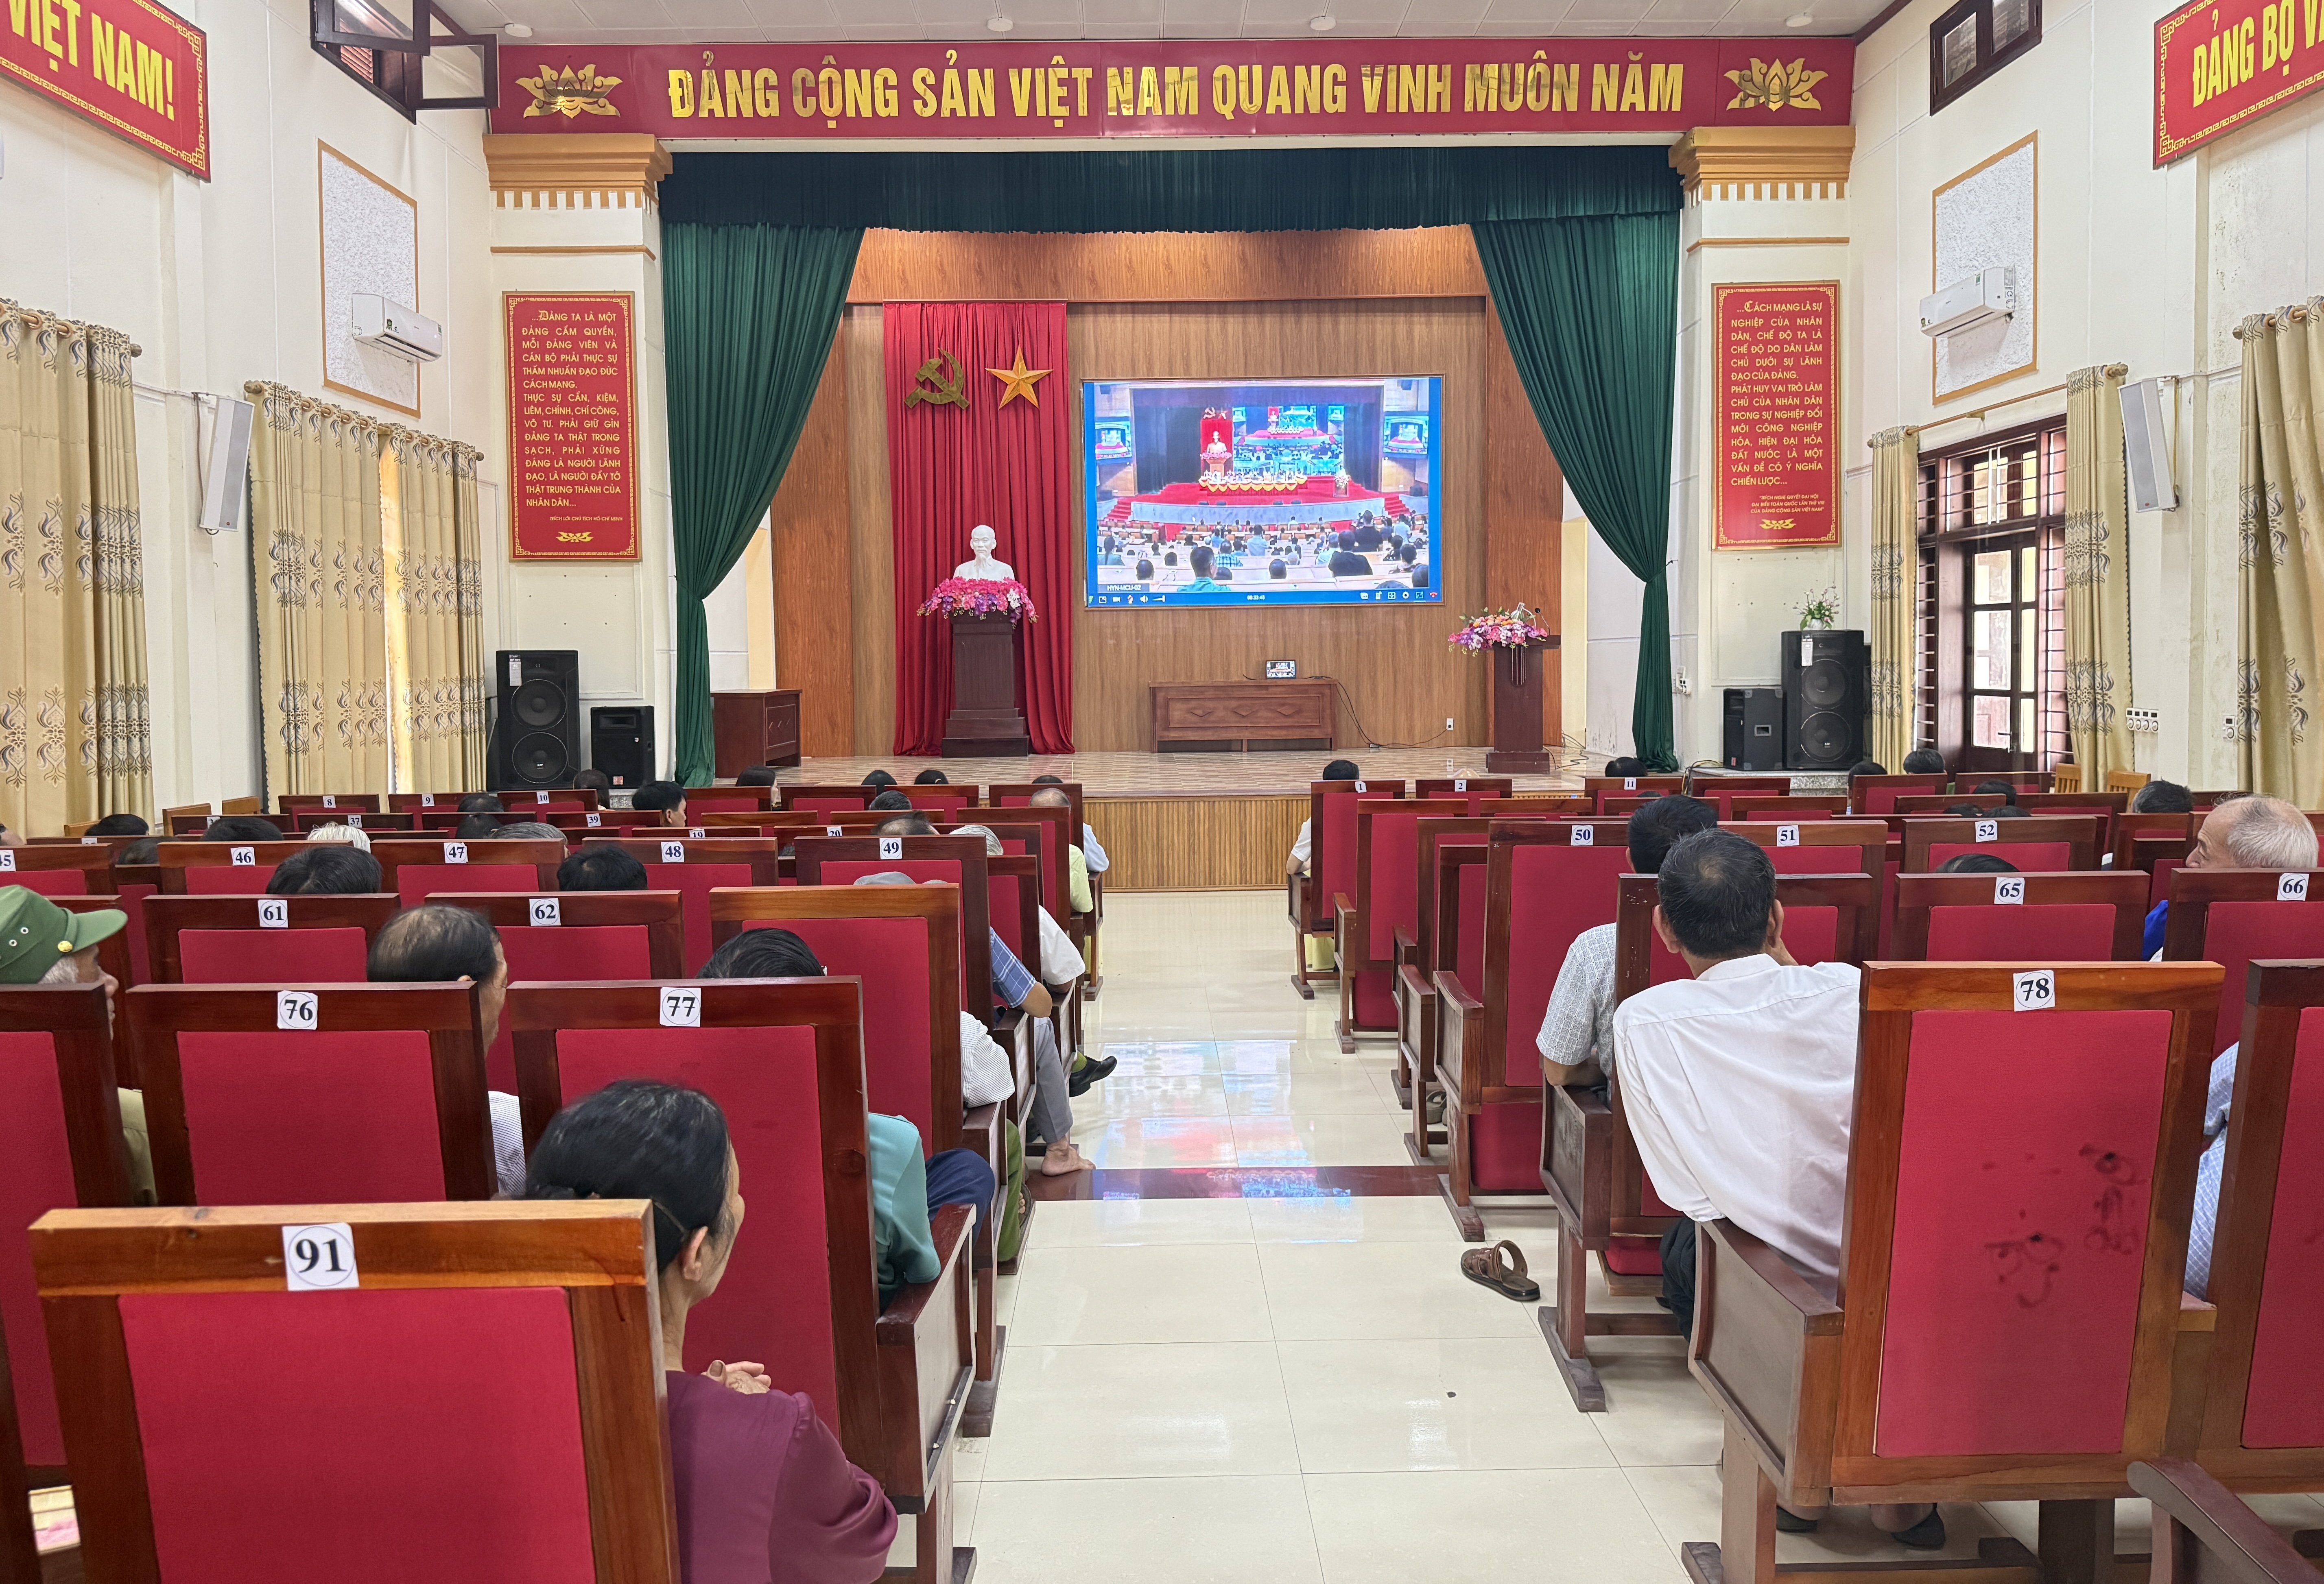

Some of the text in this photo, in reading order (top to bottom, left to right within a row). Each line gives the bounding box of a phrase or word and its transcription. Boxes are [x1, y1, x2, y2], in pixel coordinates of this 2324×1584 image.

[2193, 9, 2254, 108] ĐẢNG
[92, 12, 174, 121] NAM!
[668, 49, 1684, 128] ĐẢNG CỘNG SẢN VIỆT NAM QUANG VINH MUÔN NĂM
[1774, 303, 1800, 312] MẠNG
[1802, 301, 1811, 310] LÀ
[1813, 302, 1822, 312] SỰ
[585, 311, 595, 321] LÀ
[598, 312, 616, 323] MỘT
[1731, 316, 1822, 328] NGHIỆP CỦA NHÂN
[522, 325, 548, 335] ĐẢNG
[1731, 331, 1751, 341] DÂN,
[1779, 330, 1792, 340] ĐỘ
[1813, 329, 1822, 338] LÀ
[522, 338, 617, 349] MỖI ĐẢNG VIÊN VÀ
[1751, 344, 1764, 354] ĐỘ
[1784, 343, 1801, 352] DÂN
[1805, 342, 1822, 351] LÀM
[522, 351, 617, 364] CÁN BỘ PHẢI THỰC SỰ
[1731, 356, 1822, 367] CHỦ DƯỚI SỰ LÃNH
[579, 368, 598, 377] ĐẠO
[600, 365, 618, 375] ĐỨC
[1731, 369, 1798, 382] ĐẠO CỦA ĐẢNG.
[523, 378, 577, 390] CÁCH MẠNG.
[1731, 383, 1751, 393] PHÁT
[1787, 382, 1803, 392] TRÒ
[1805, 382, 1822, 391] LÀM
[524, 393, 545, 403] THỰC
[552, 393, 561, 403] SỰ
[597, 393, 618, 403] KIỆM,
[1731, 395, 1822, 406] CHỦ CỦA NHÂN DÂN
[524, 405, 619, 416] LIÊM, CHÍNH, CHÍ CÔNG,
[1731, 412, 1760, 420] TRONG
[1762, 411, 1772, 420] SỰ
[1774, 409, 1804, 419] NGHIỆP
[524, 419, 537, 428] VÔ
[560, 418, 578, 428] PHẢI
[584, 419, 599, 428] GIỮ
[604, 418, 619, 428] GÌN
[1731, 421, 1823, 433] MỚI CÔNG NGHIỆP
[525, 431, 550, 441] ĐẢNG
[568, 432, 587, 442] THẬT
[1732, 434, 1823, 447] HÓA, HIỆN ĐẠI HÓA
[525, 444, 620, 455] SẠCH, PHẢI XỨNG
[1731, 448, 1823, 459] ĐẤT NƯỚC LÀ MỘT
[525, 458, 620, 467] ĐÁNG LÀ NGƯỜI LÃNH
[1768, 461, 1782, 471] CÓ
[1786, 461, 1791, 471] Ý
[1795, 461, 1823, 471] NGHĨA
[526, 473, 547, 482] ĐẠO,
[549, 471, 559, 480] LÀ
[561, 471, 588, 480] NGƯỜI
[526, 484, 545, 495] THẬT
[574, 484, 601, 493] THÀNH
[603, 484, 621, 493] CỦA
[526, 497, 550, 506] NHÂN
[1575, 829, 1590, 840] 50
[1780, 829, 1795, 841] 51
[1979, 825, 1994, 836] 52
[449, 847, 464, 858] 47
[665, 846, 681, 857] 48
[883, 842, 899, 853] 49
[236, 852, 251, 863] 46
[2000, 883, 2021, 897] 65
[2283, 879, 2305, 893] 66
[264, 905, 284, 920] 61
[535, 904, 556, 919] 62
[2020, 978, 2049, 1001] 78
[284, 999, 313, 1021] 76
[667, 996, 695, 1017] 77
[295, 1239, 347, 1273] 91
